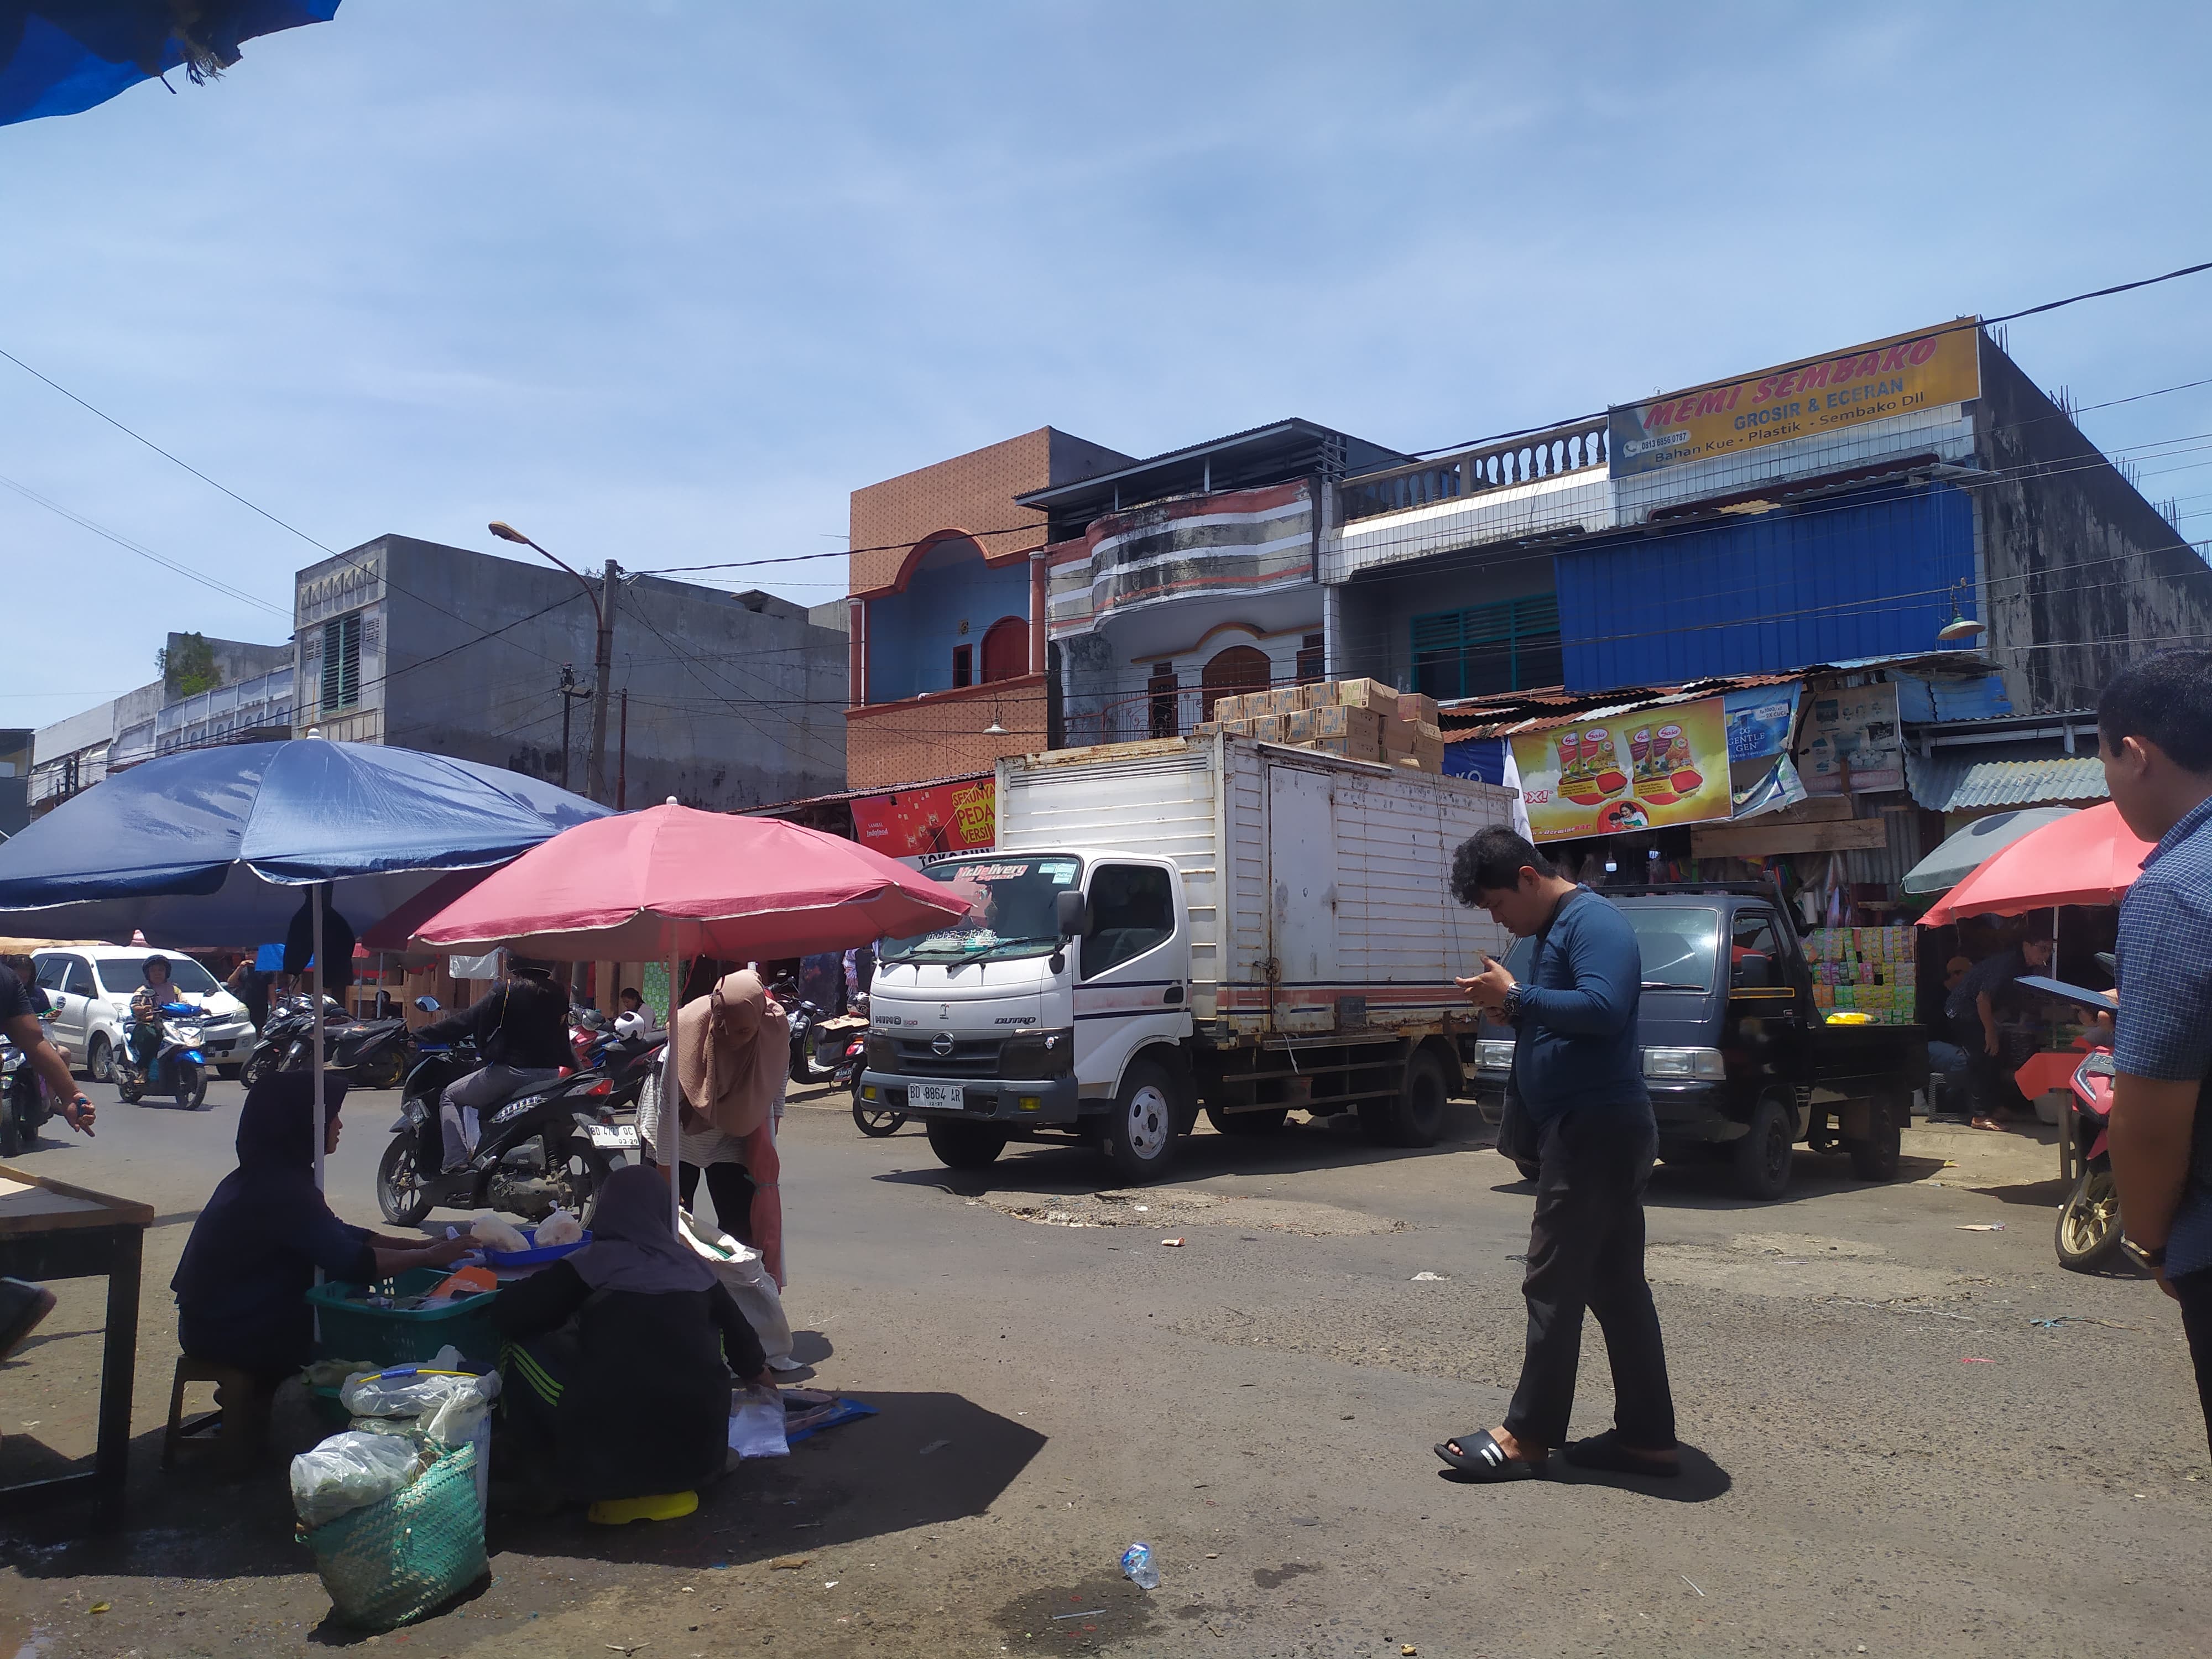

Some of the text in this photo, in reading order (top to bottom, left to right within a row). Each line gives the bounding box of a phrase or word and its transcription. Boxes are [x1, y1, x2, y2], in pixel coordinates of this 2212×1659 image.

[1643, 338, 1937, 429] MEMI SEMBAKO
[1734, 378, 1903, 430] GROSIR & ECERAN
[1656, 392, 1924, 462] Bahan Kue Plastik Sembako Dll
[1642, 439, 1656, 450] 0813
[1672, 432, 1686, 444] 0787
[1728, 733, 1765, 745] GENTLE
[1736, 742, 1757, 752] GEN
[953, 785, 995, 806] SERUNYA
[956, 803, 995, 827] PEDA
[867, 828, 889, 838] Indofood
[956, 864, 1029, 877] Mr.Delivery
[875, 1015, 901, 1025] HINO
[994, 1016, 1036, 1025] DUTRO
[910, 1086, 961, 1102] BD 8864 AR
[501, 1096, 539, 1117] STREET
[591, 1127, 601, 1135] BD
